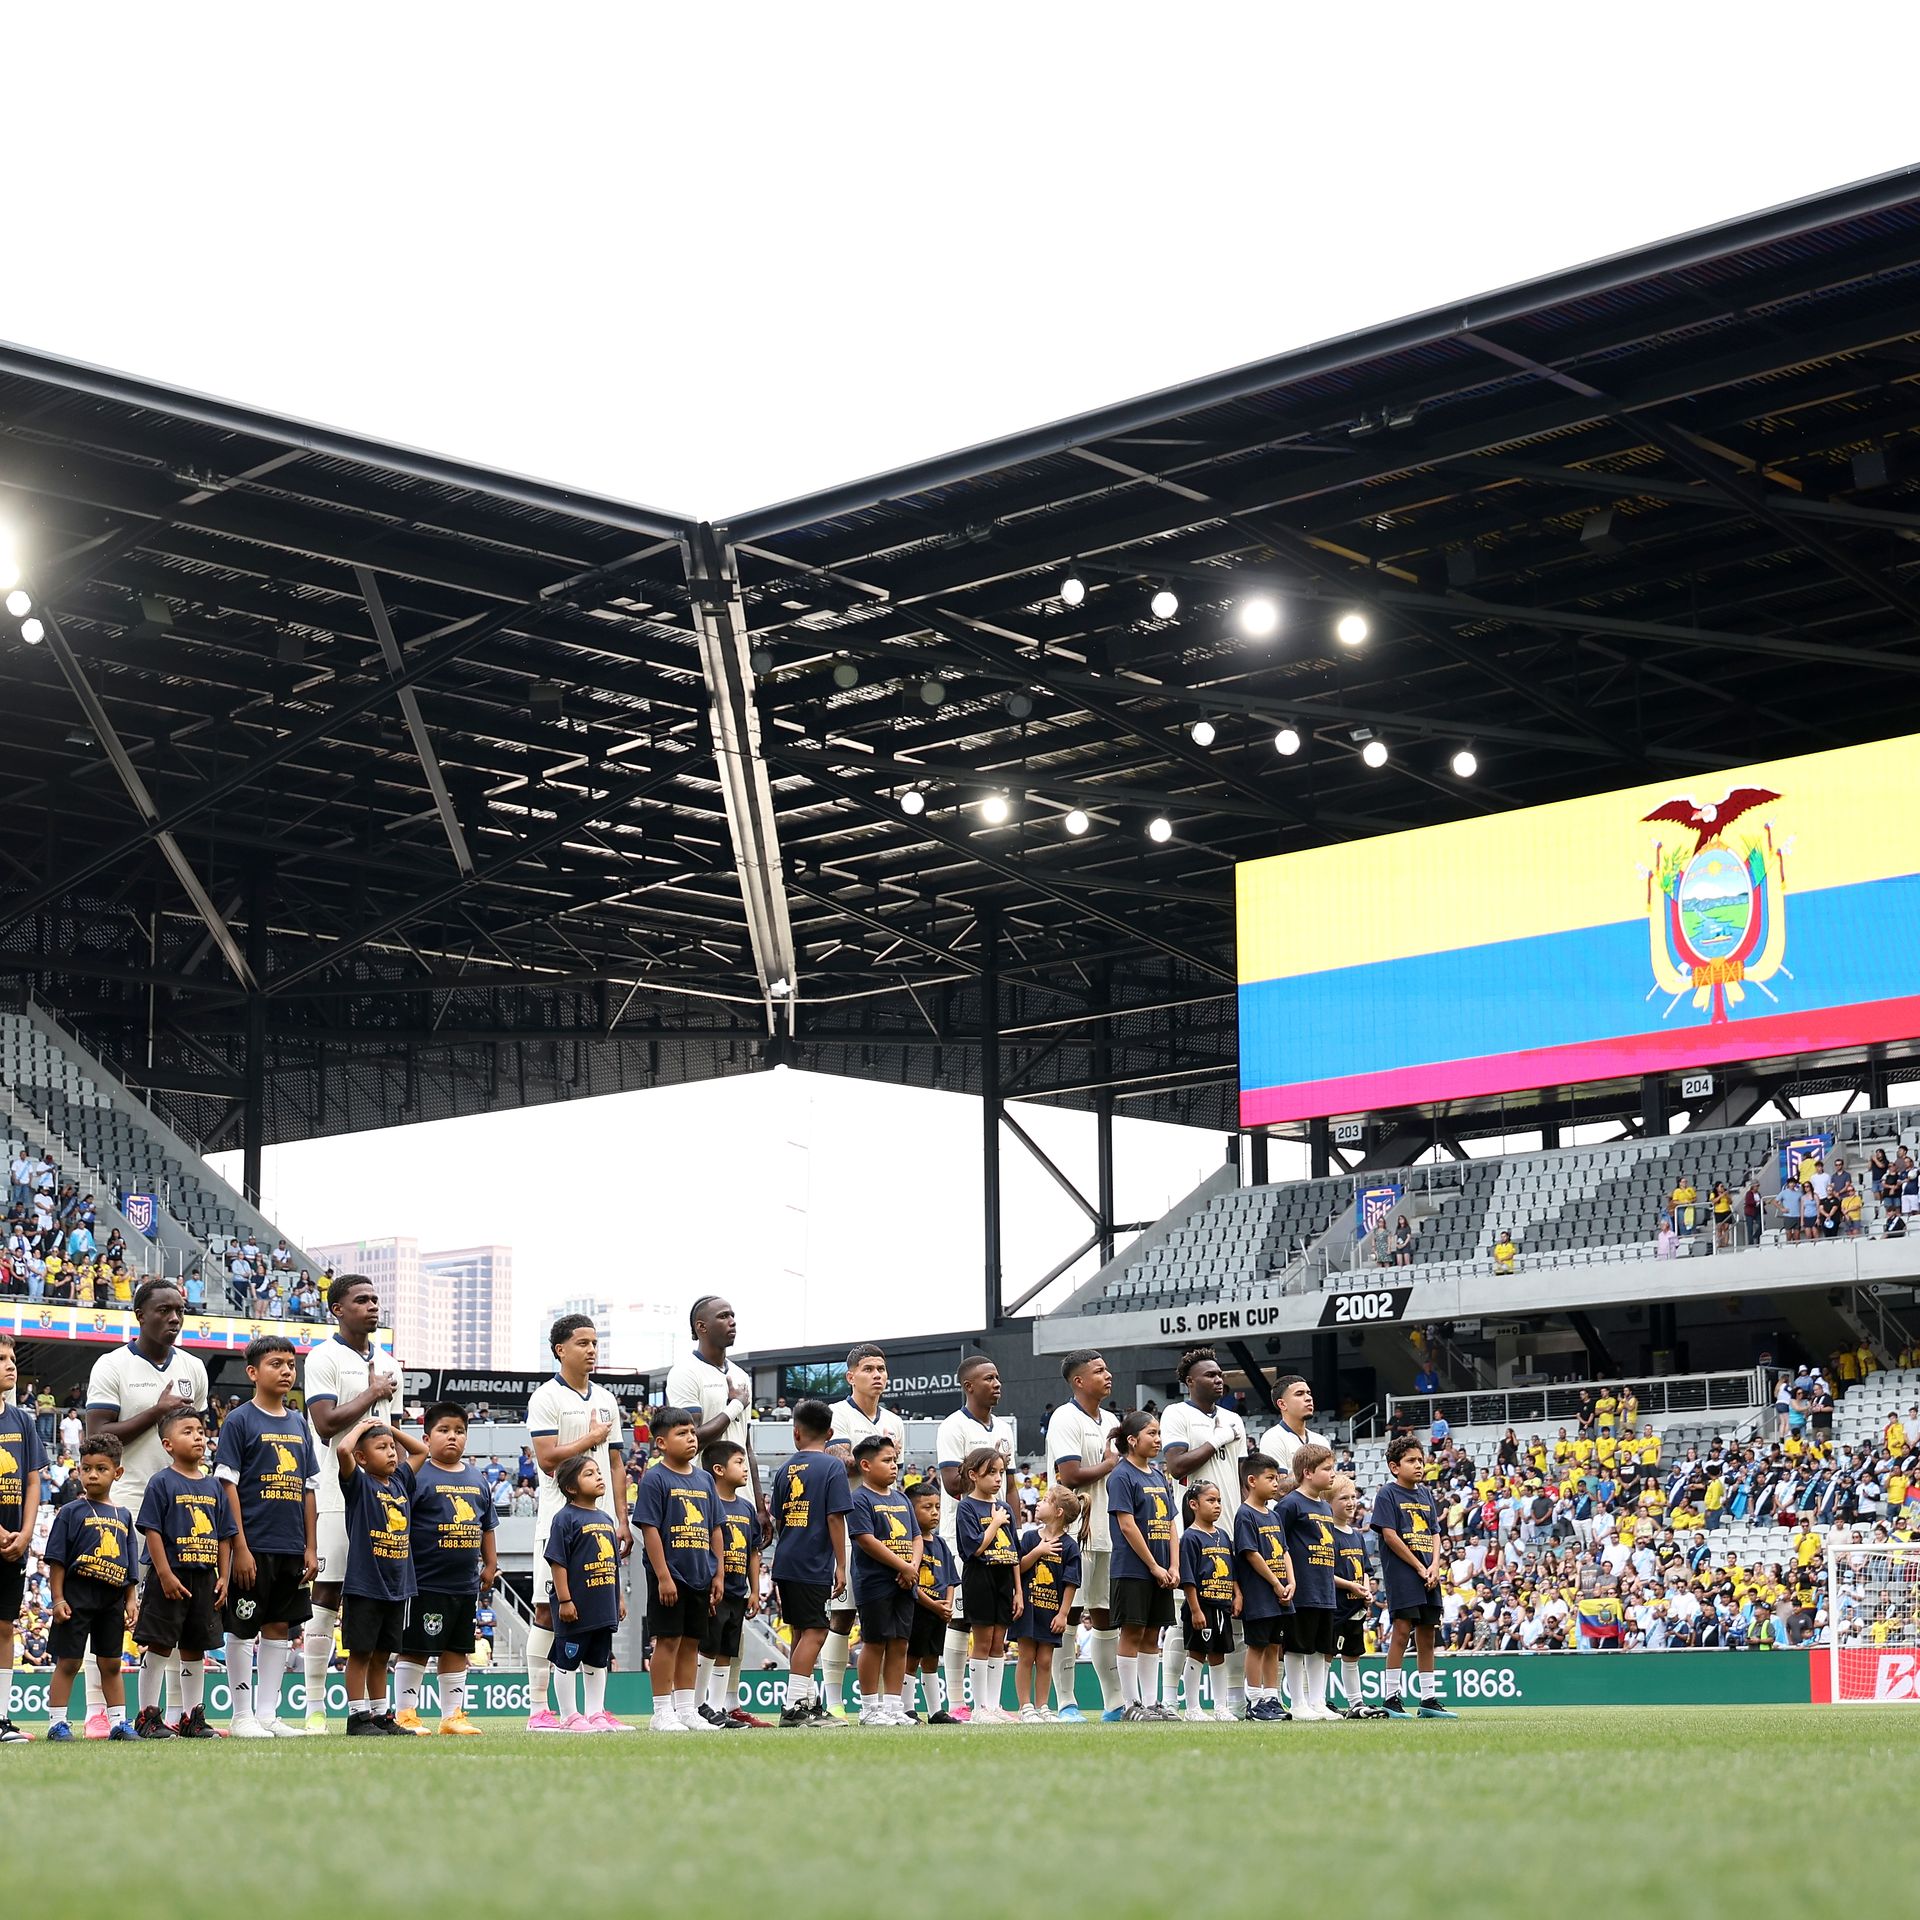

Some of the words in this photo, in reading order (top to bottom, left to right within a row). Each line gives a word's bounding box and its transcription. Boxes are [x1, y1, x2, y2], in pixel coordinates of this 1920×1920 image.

[1685, 1079, 1710, 1094] 204
[1338, 1125, 1359, 1140] 203
[1335, 1293, 1394, 1322] 2002
[1160, 1316, 1191, 1335] U.S.
[1197, 1310, 1240, 1331] OPEN
[1246, 1307, 1279, 1325] CUP
[403, 1372, 431, 1395] EP
[445, 1379, 524, 1393] AMERICAN
[600, 1383, 644, 1396] OWER
[1452, 1668, 1522, 1698] 1868.
